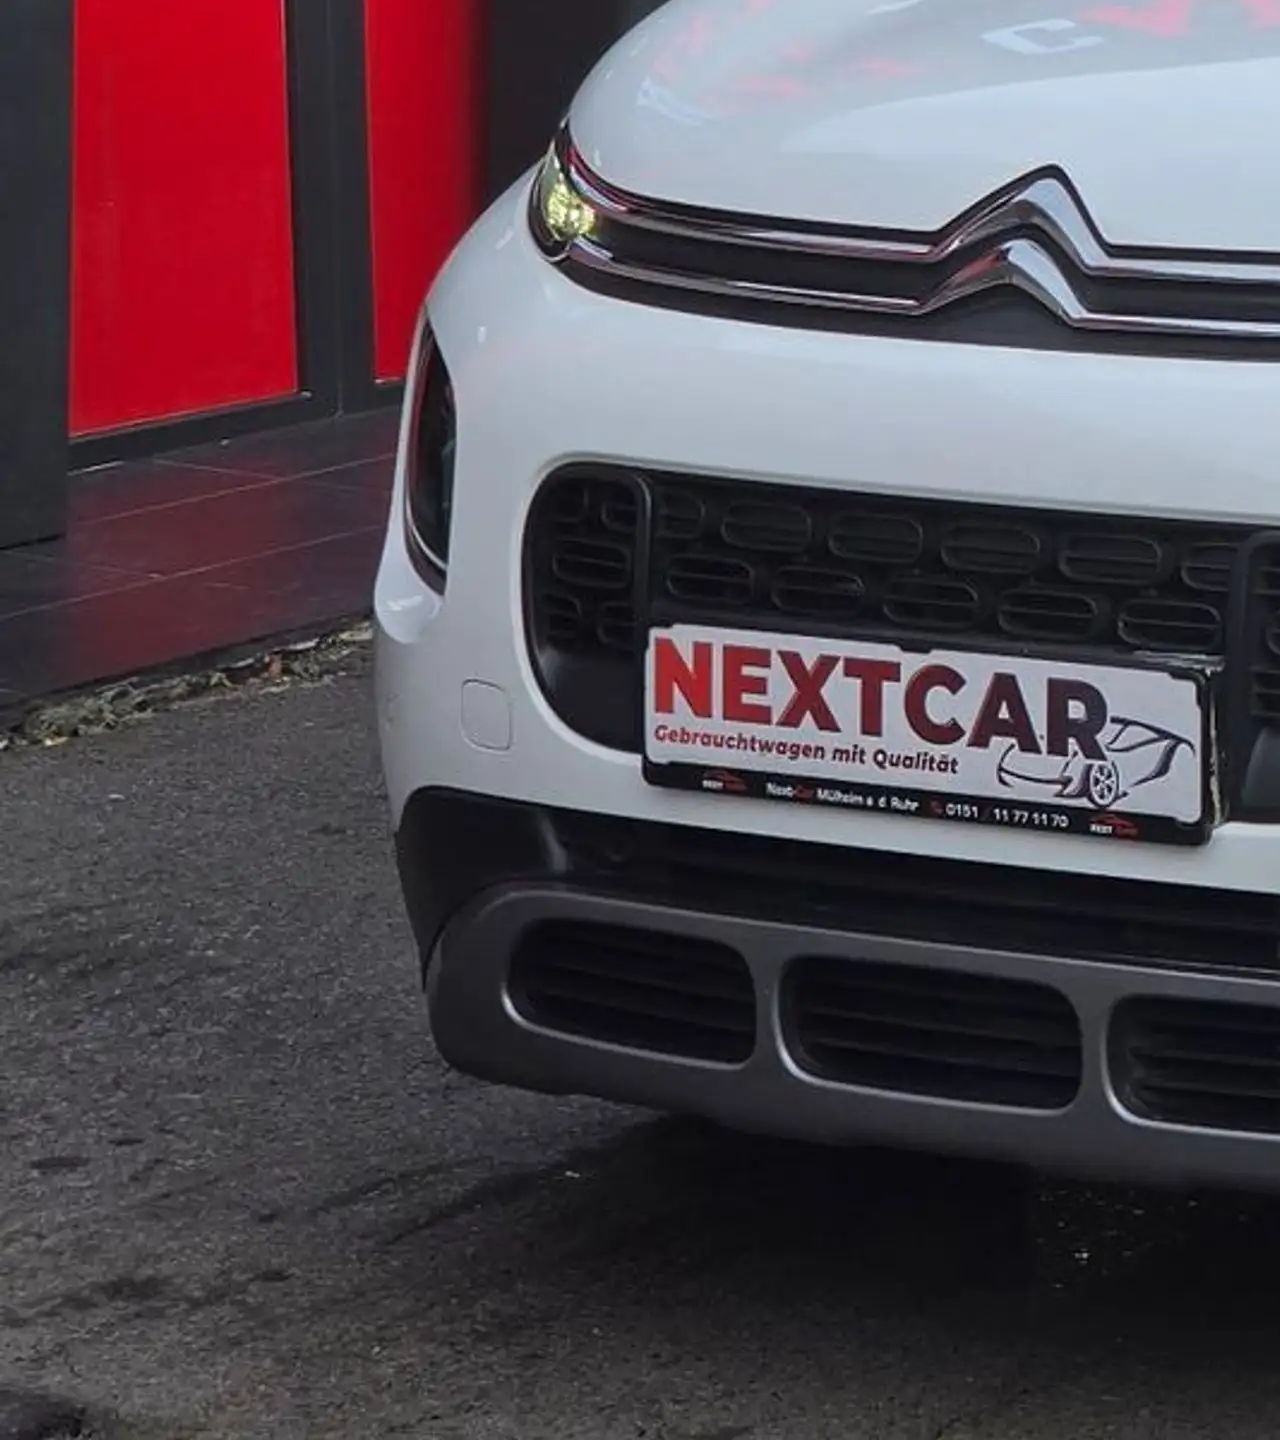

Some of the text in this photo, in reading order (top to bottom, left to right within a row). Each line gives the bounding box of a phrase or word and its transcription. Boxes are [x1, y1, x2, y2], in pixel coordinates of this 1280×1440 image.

[653, 636, 1108, 761] NEXTCAR
[654, 724, 960, 775] Gebrauchtwagen mit Qualität
[945, 803, 979, 819] 0151
